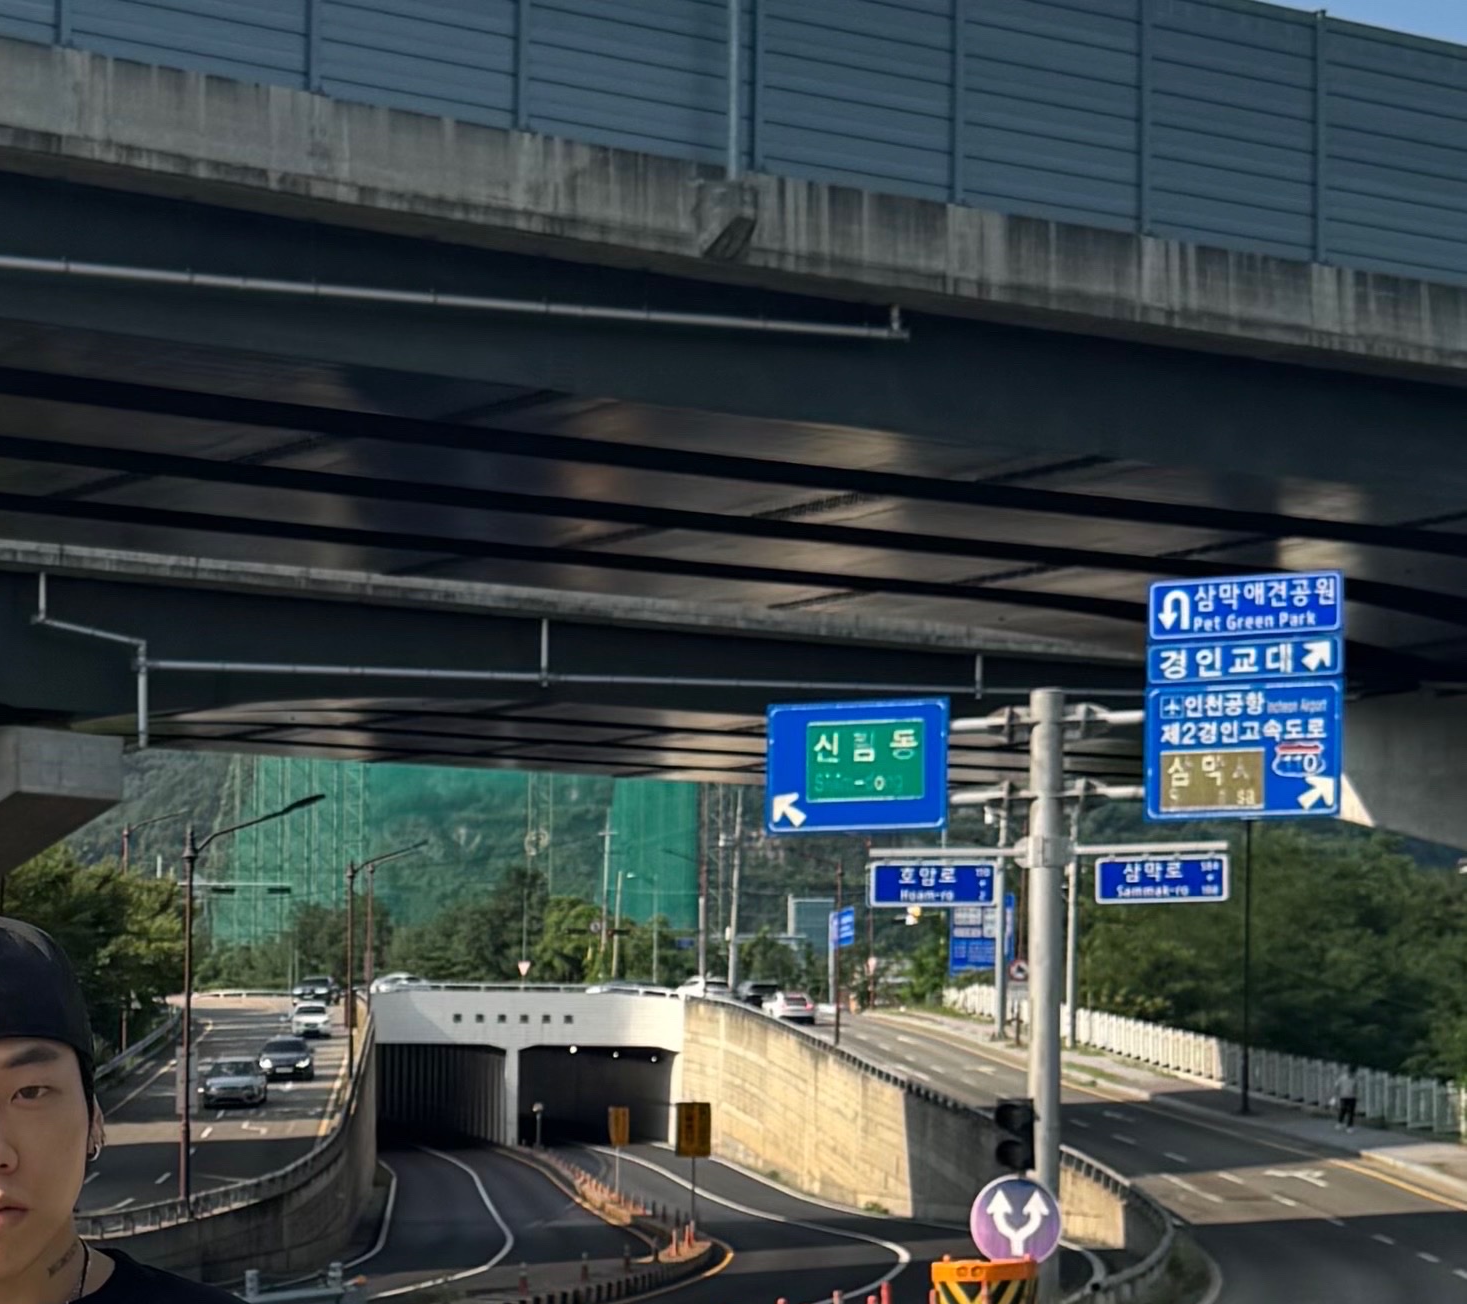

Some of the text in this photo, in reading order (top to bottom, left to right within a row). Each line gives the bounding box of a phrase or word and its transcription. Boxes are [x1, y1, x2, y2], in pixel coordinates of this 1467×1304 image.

[1194, 578, 1335, 612] 삼막애견공원
[1193, 610, 1316, 632] Pet Green Park
[1159, 642, 1292, 679] 경인교대
[1185, 691, 1265, 718] 인천공항
[1160, 718, 1327, 745] 제2경인고속도로
[813, 729, 919, 763] 신림동
[898, 867, 957, 887] 호암로
[1123, 862, 1184, 883] 삼막로
